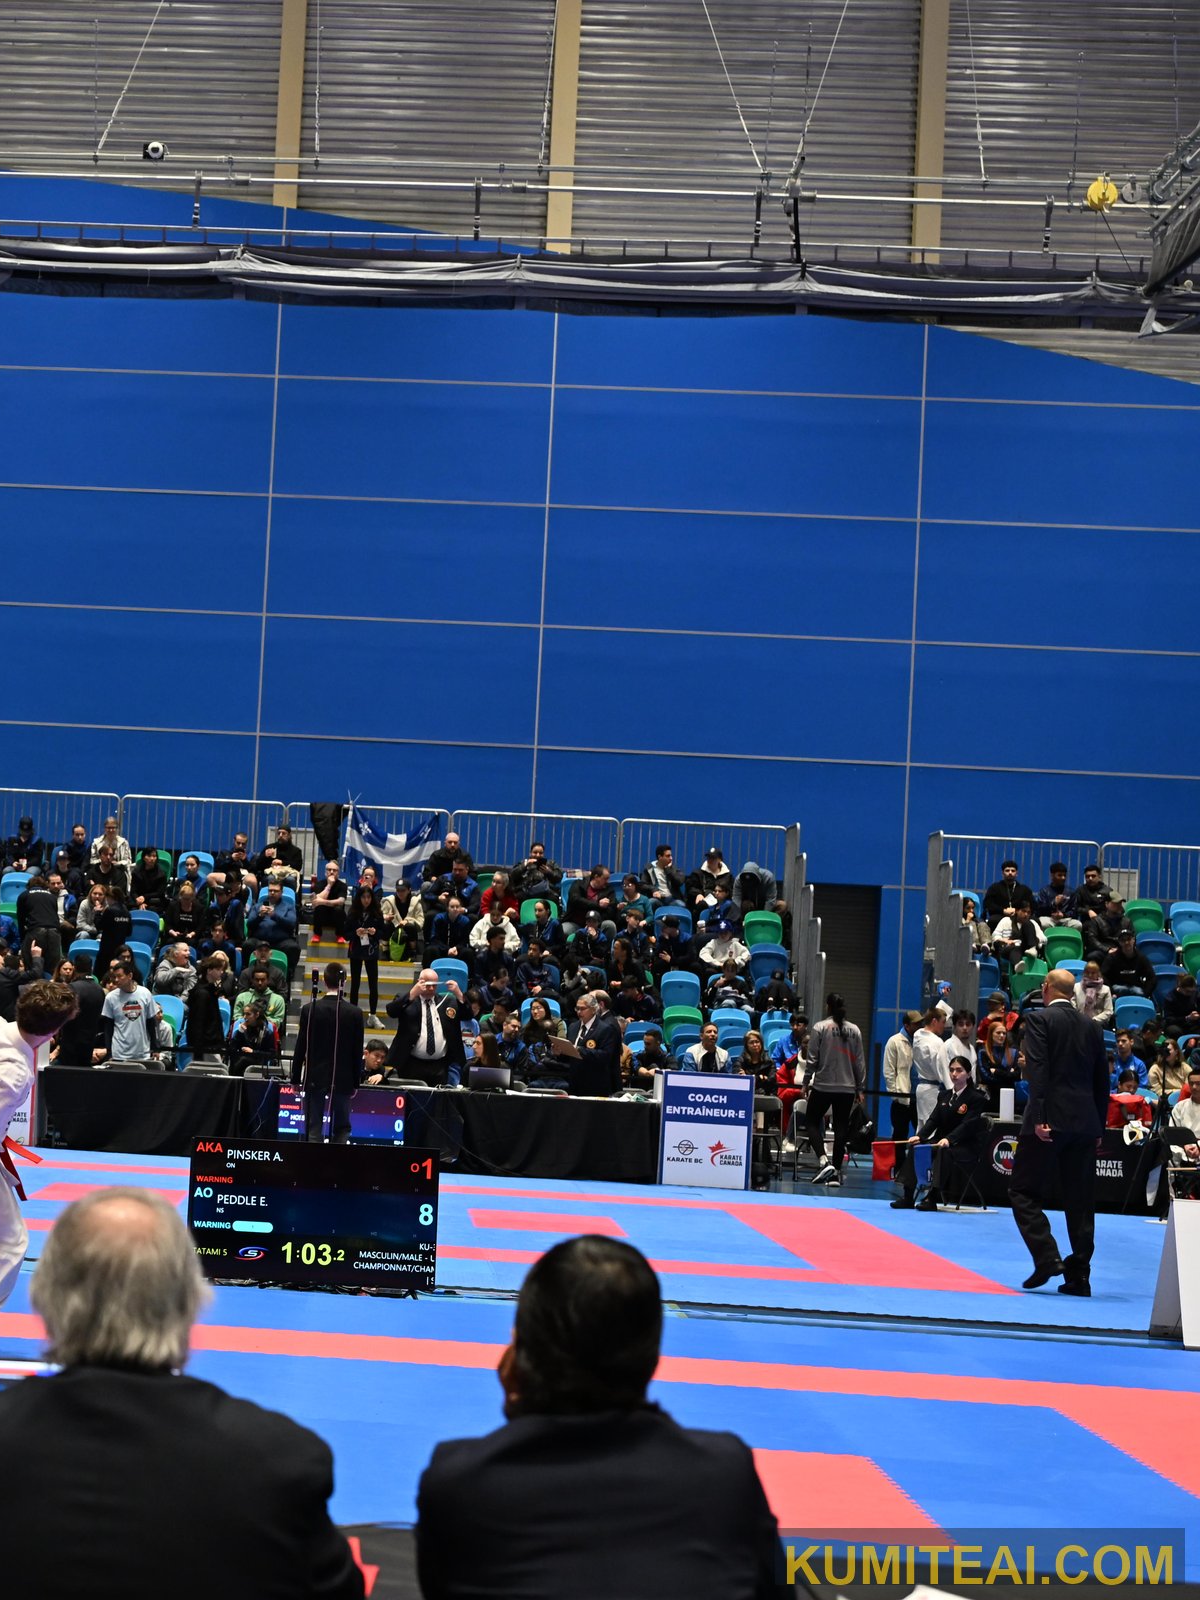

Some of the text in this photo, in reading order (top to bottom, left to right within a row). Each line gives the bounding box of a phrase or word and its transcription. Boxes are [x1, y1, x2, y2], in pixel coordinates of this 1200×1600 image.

[280, 1087, 294, 1095] AKA
[396, 1096, 405, 1109] 0
[688, 1093, 727, 1103] COACH
[278, 1110, 290, 1118] AO
[394, 1119, 404, 1133] 0
[196, 1141, 284, 1162] AKA PINSKER A.
[999, 1150, 1016, 1160] WK
[666, 1156, 693, 1164] KARATE
[1095, 1159, 1123, 1169] ARATE
[421, 1158, 433, 1180] 1
[1095, 1167, 1124, 1178] ANADA
[196, 1175, 233, 1184] WARNING
[193, 1186, 268, 1207] AO PEDDLE E.
[418, 1203, 434, 1226] 8
[193, 1220, 231, 1229] WARNING
[193, 1247, 221, 1256] TATAMI
[281, 1241, 345, 1266] 1:03.2
[359, 1250, 423, 1262] MASCULIN/MALE
